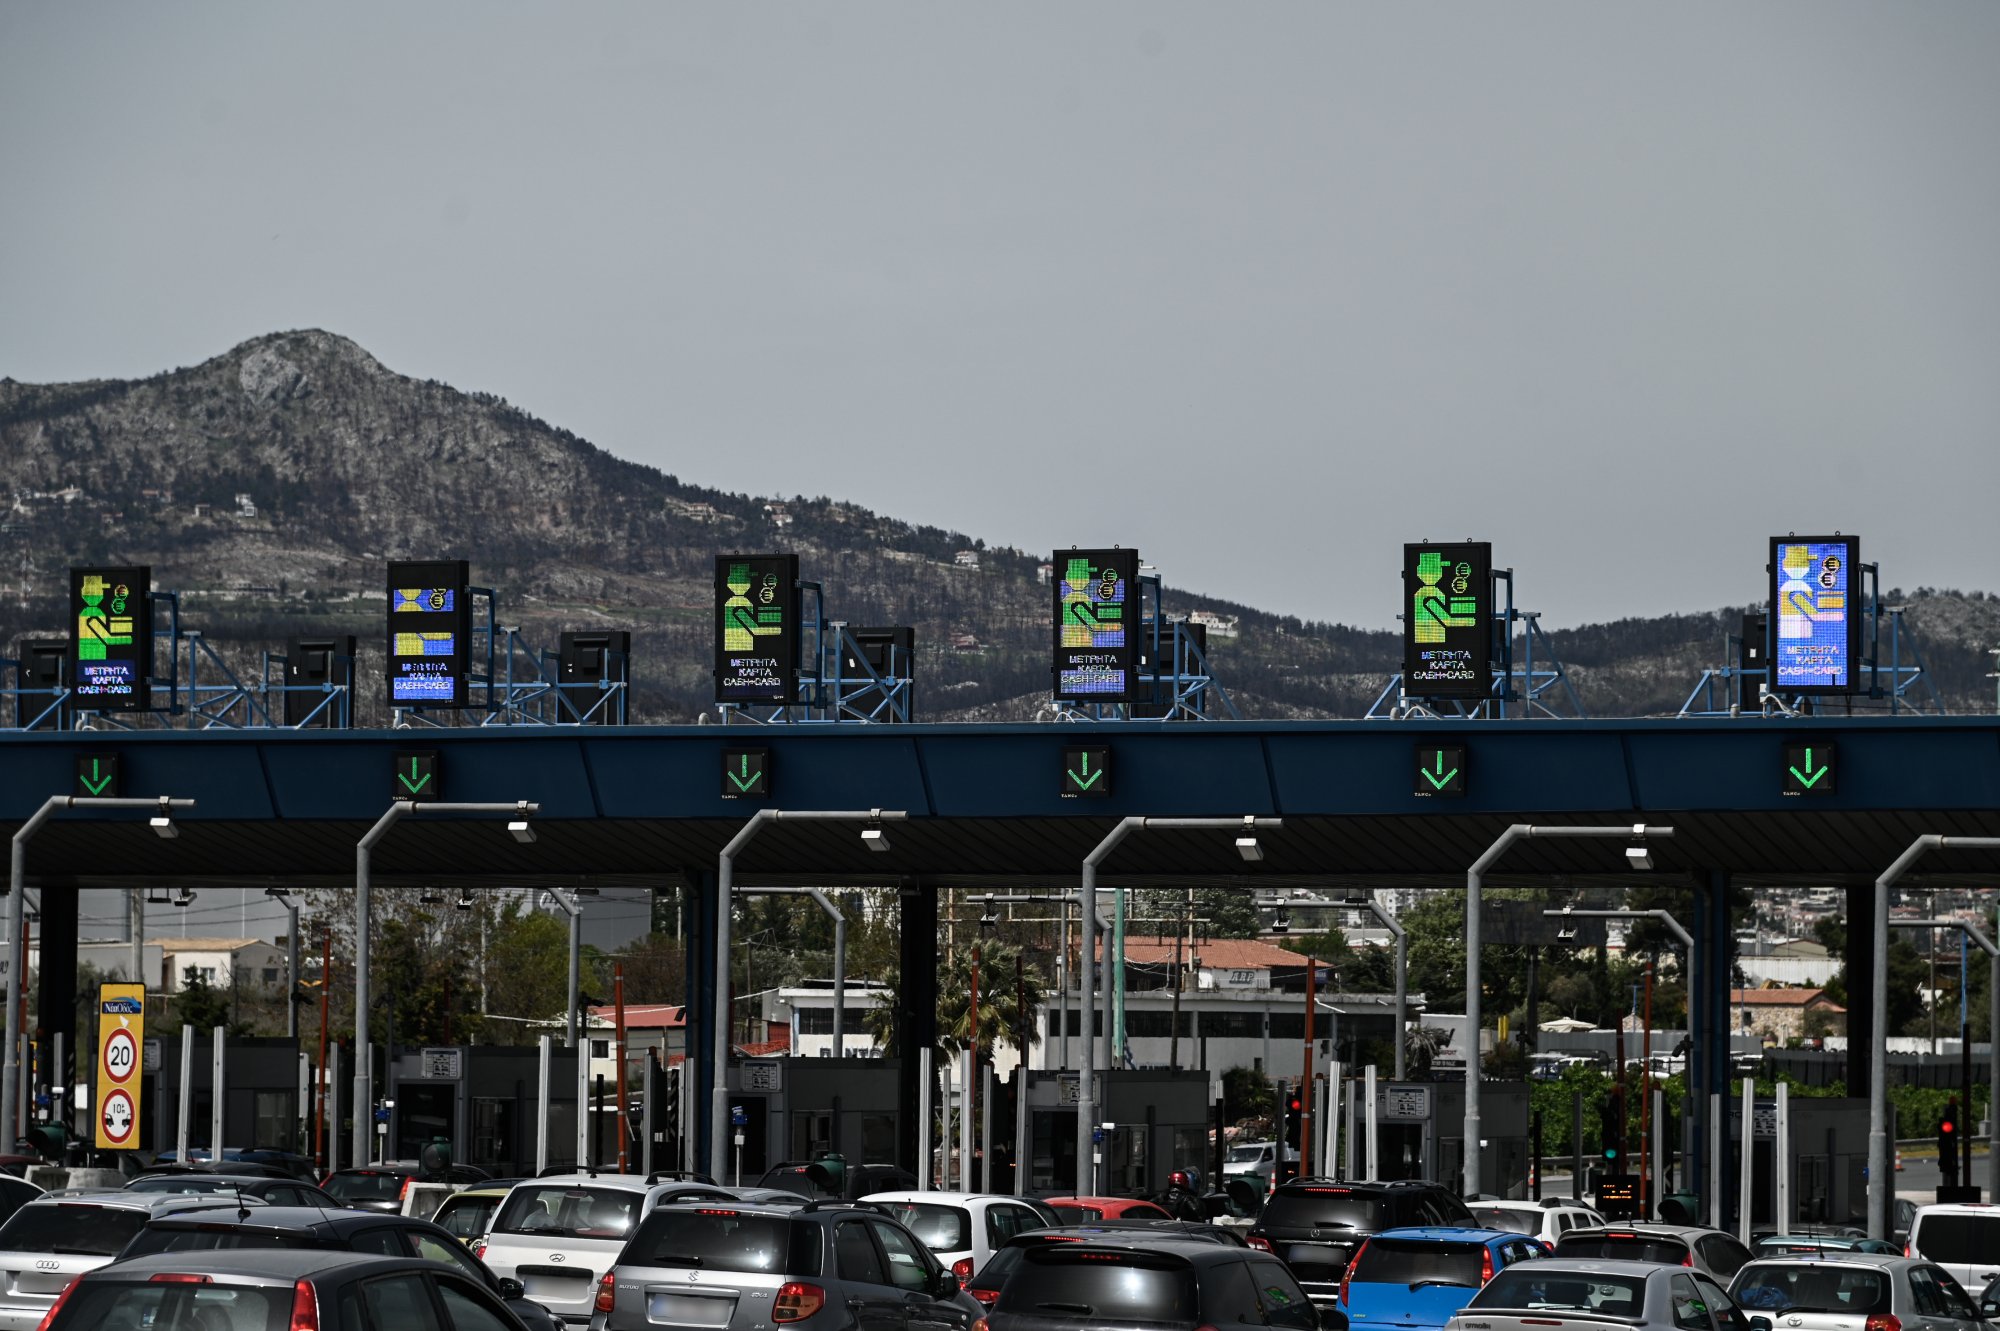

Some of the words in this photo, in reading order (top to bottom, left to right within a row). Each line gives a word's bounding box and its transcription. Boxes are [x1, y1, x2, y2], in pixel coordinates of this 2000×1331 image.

[1429, 660, 1465, 669] ΚΑΡΤΑ
[738, 668, 773, 677] ΚΑΡΤΑ
[111, 1046, 130, 1066] 20
